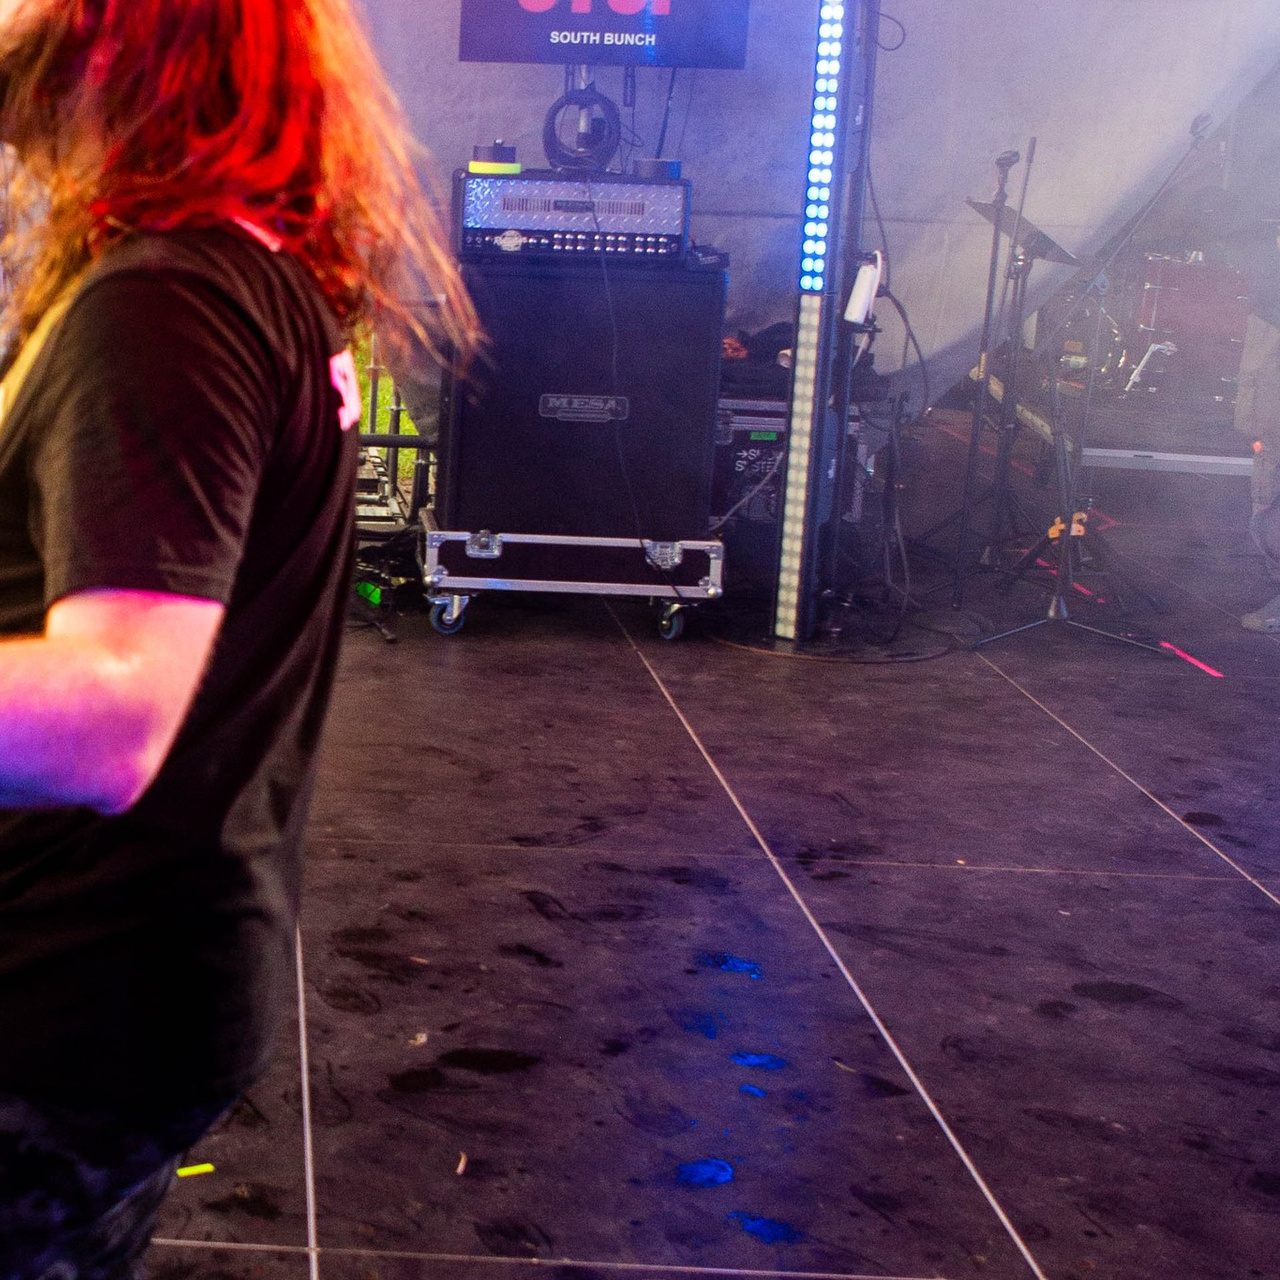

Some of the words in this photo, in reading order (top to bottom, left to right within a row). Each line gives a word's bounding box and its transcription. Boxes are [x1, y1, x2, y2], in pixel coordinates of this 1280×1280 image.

[549, 31, 600, 45] SOUTH
[603, 33, 656, 46] BUNCH
[547, 398, 622, 410] MESA
